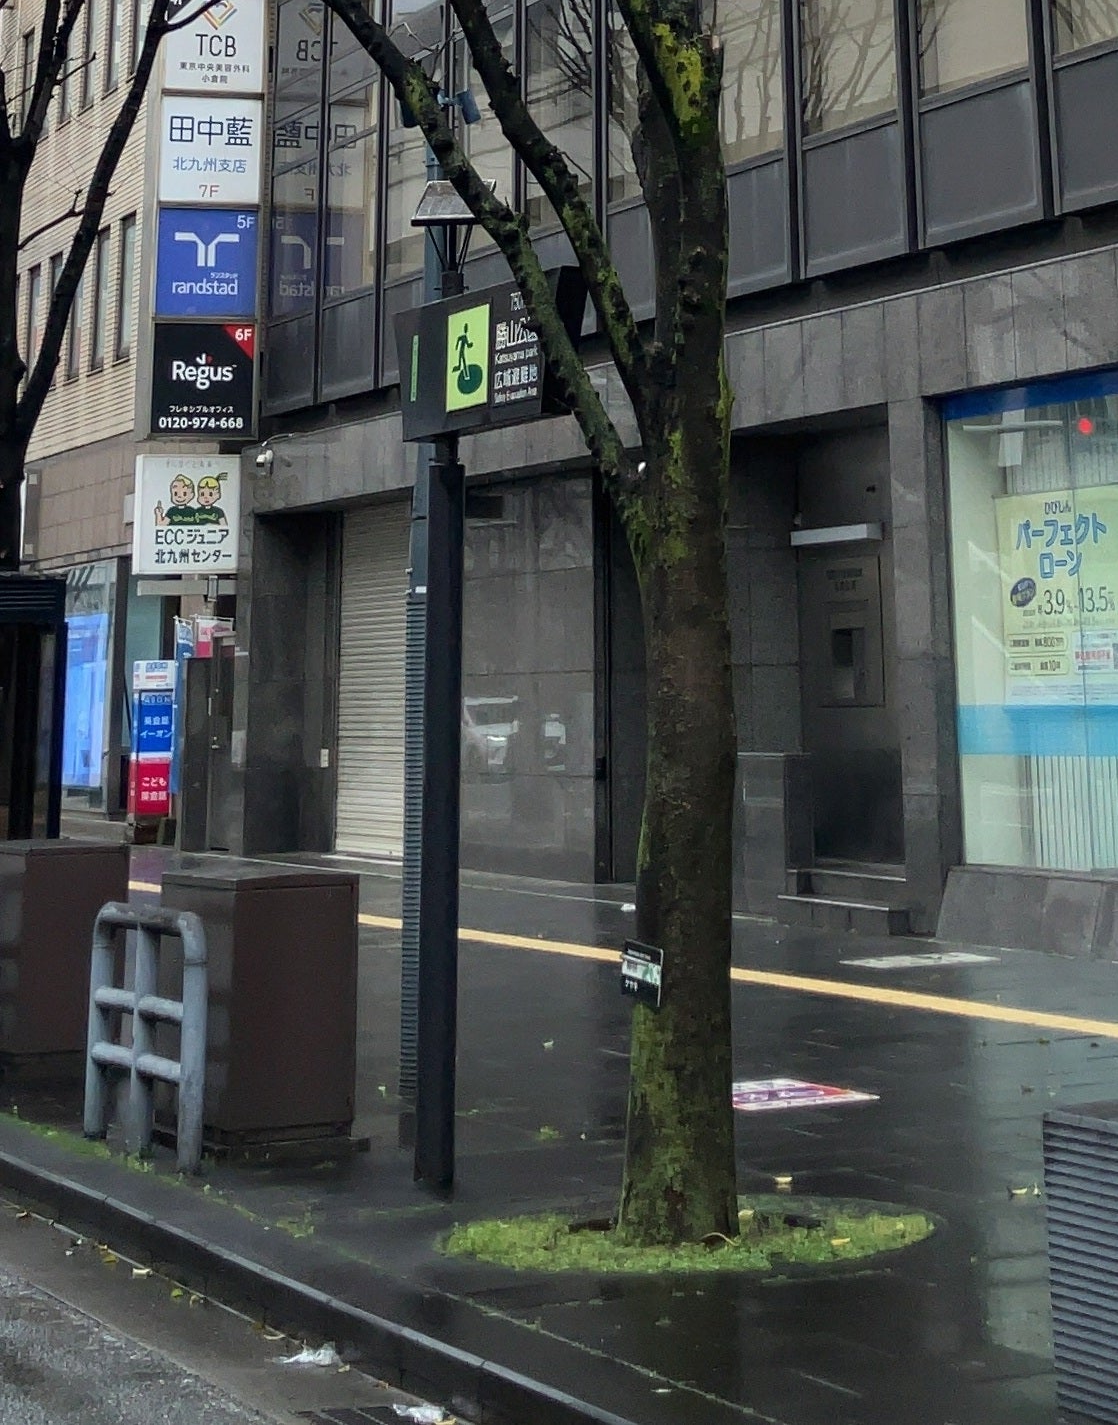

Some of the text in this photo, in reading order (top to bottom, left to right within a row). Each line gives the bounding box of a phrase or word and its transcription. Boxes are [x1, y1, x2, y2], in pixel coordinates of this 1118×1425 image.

[195, 33, 237, 58] TCB
[169, 115, 253, 147] 田中藍
[173, 156, 247, 174] 北九州支店
[198, 184, 220, 198] 7F
[236, 215, 255, 229] 5F
[172, 278, 239, 296] randstad
[234, 328, 253, 341] 6F
[171, 353, 234, 390] Regus
[158, 416, 244, 429] 0120-974-668
[1016, 512, 1107, 550] パーフェクト
[155, 548, 232, 564] 北九州センター
[1039, 550, 1083, 579] ローン
